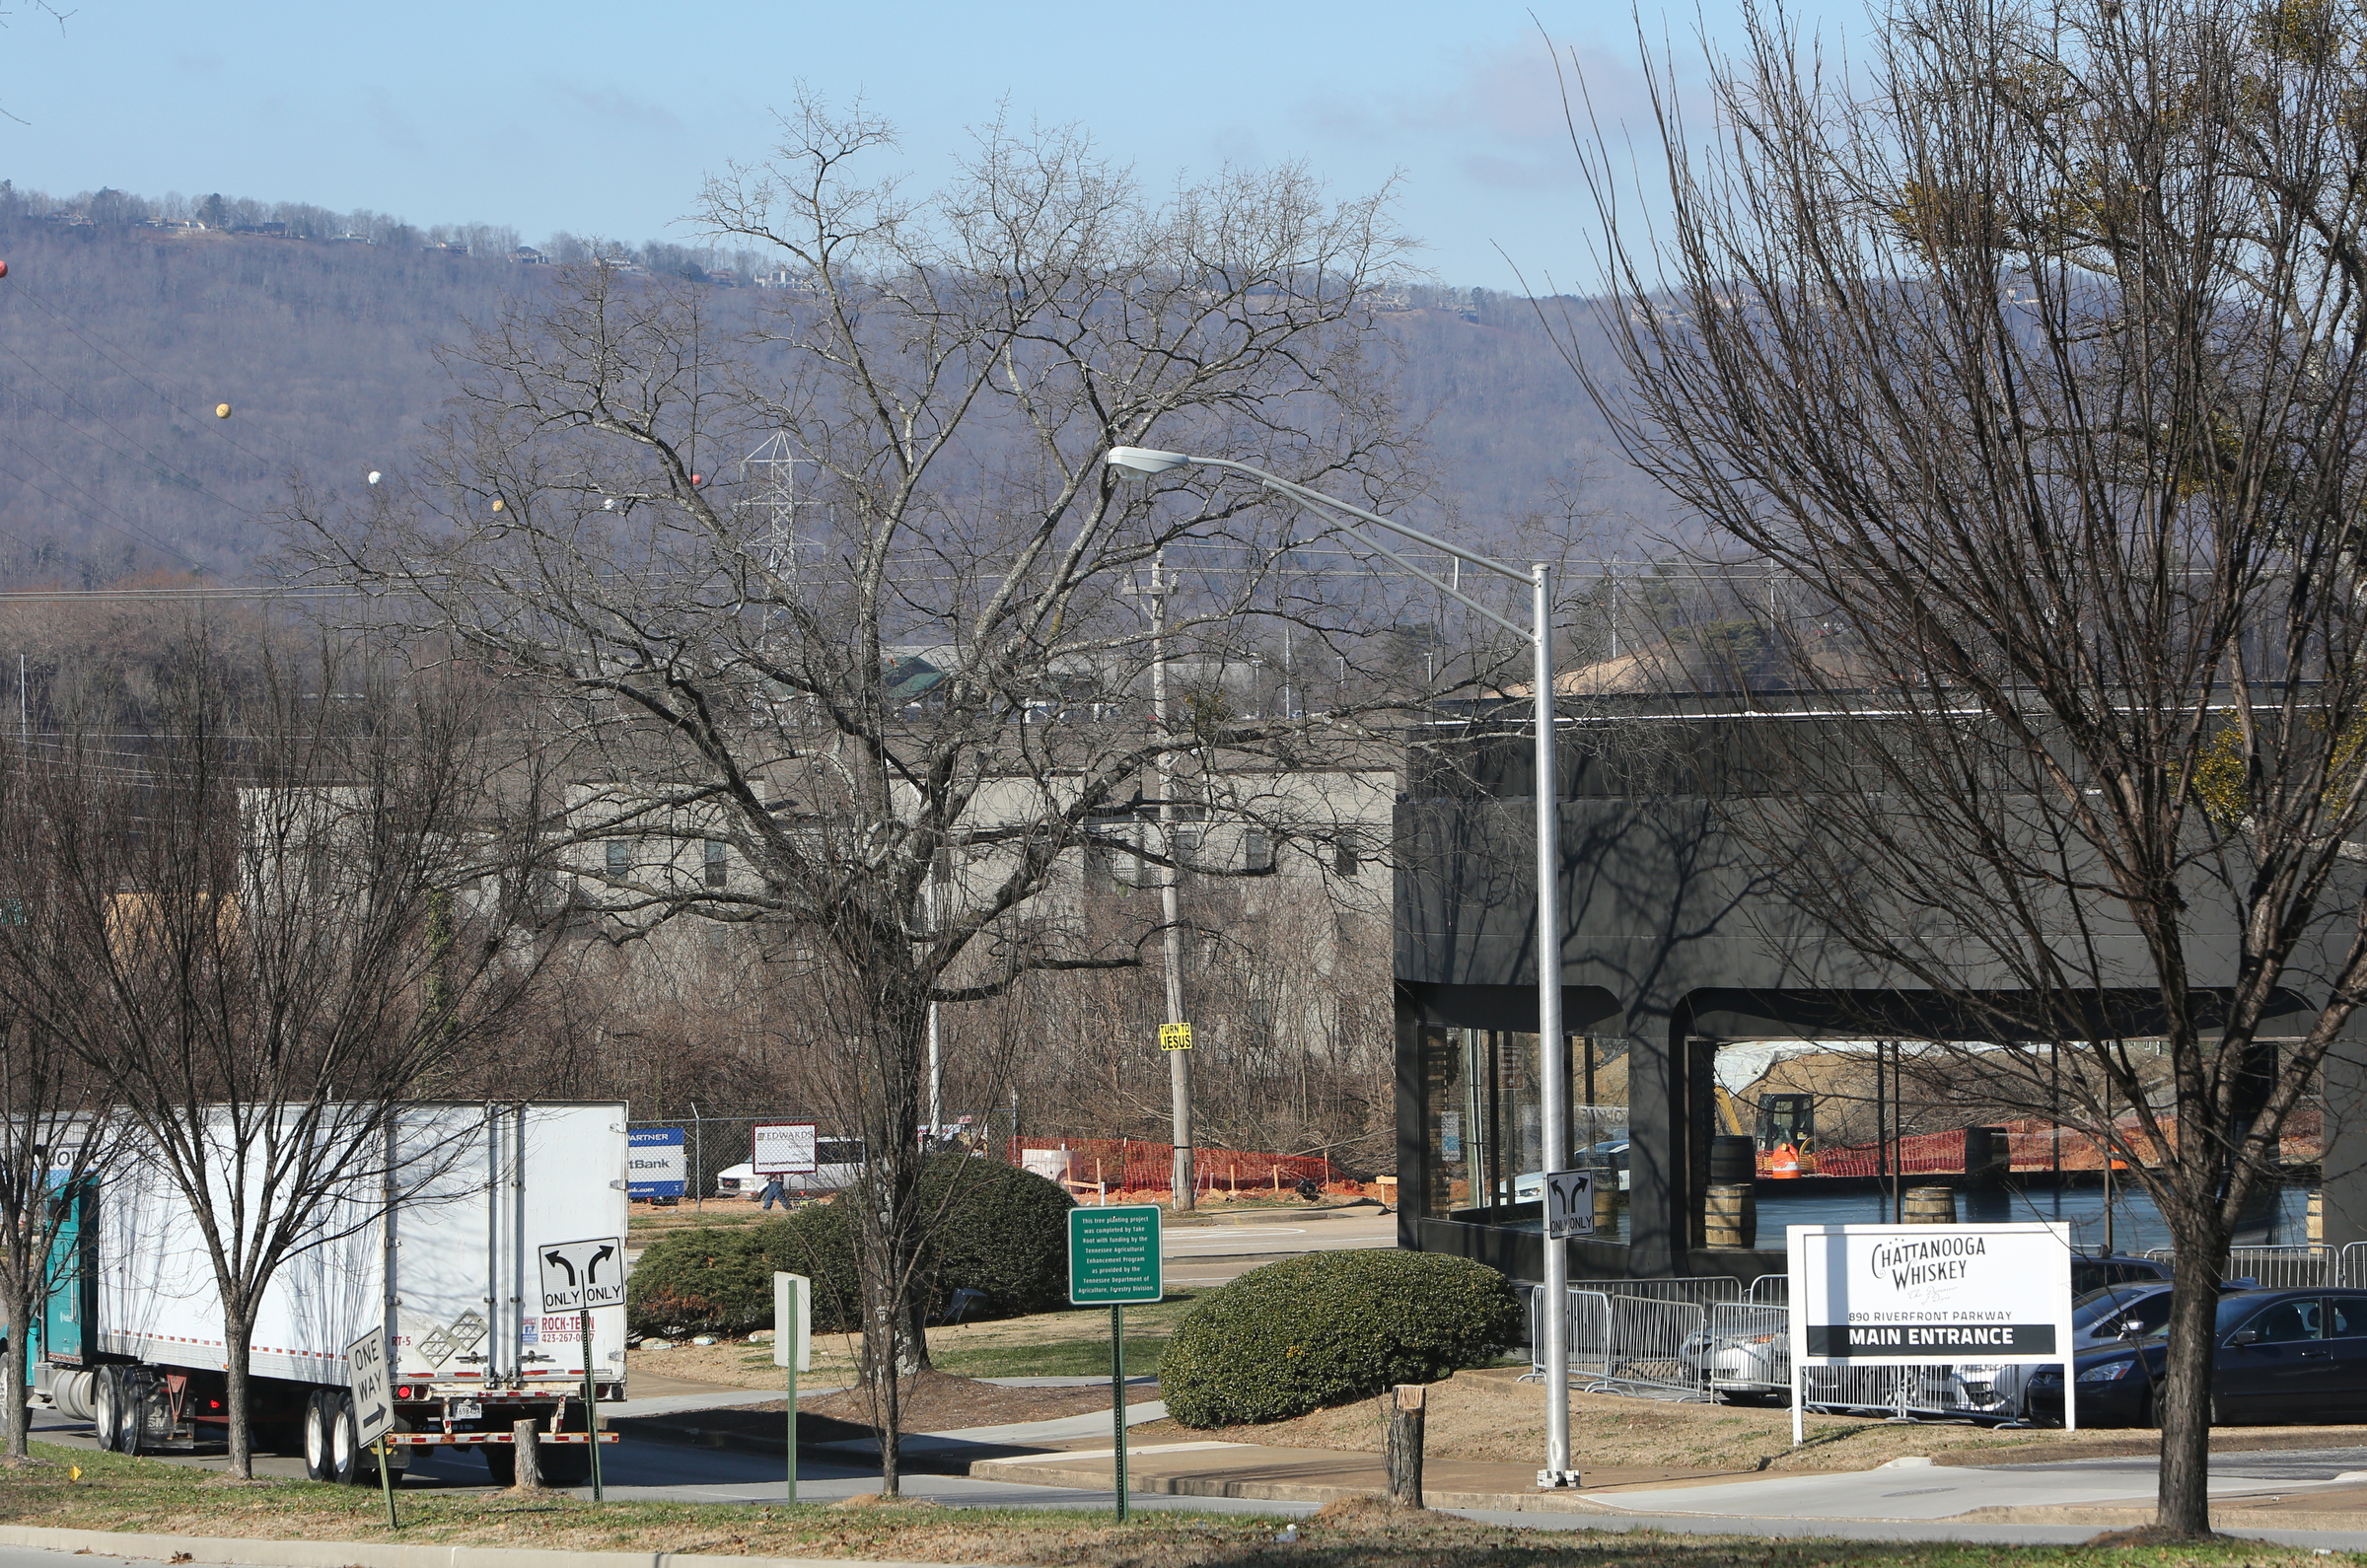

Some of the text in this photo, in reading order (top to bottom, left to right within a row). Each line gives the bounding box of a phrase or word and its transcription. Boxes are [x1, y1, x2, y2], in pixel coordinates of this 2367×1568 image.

[1160, 1023, 1190, 1034] TURN TO
[1162, 1034, 1191, 1049] JESUS
[766, 1130, 814, 1140] EDWARDS
[1550, 1218, 1568, 1233] ONLY
[1570, 1216, 1593, 1230] ONLY
[1892, 1259, 1968, 1292] WHISKEY
[544, 1290, 580, 1307] ONLY
[586, 1284, 621, 1302] ONLY
[541, 1317, 595, 1330] ROCK-TEN
[1848, 1311, 2013, 1321] 890 RIVERFRONT PARKWAY
[1849, 1327, 2014, 1345] MAIN ENTRANCE
[355, 1338, 380, 1372] ONE
[358, 1369, 382, 1403] WAY
